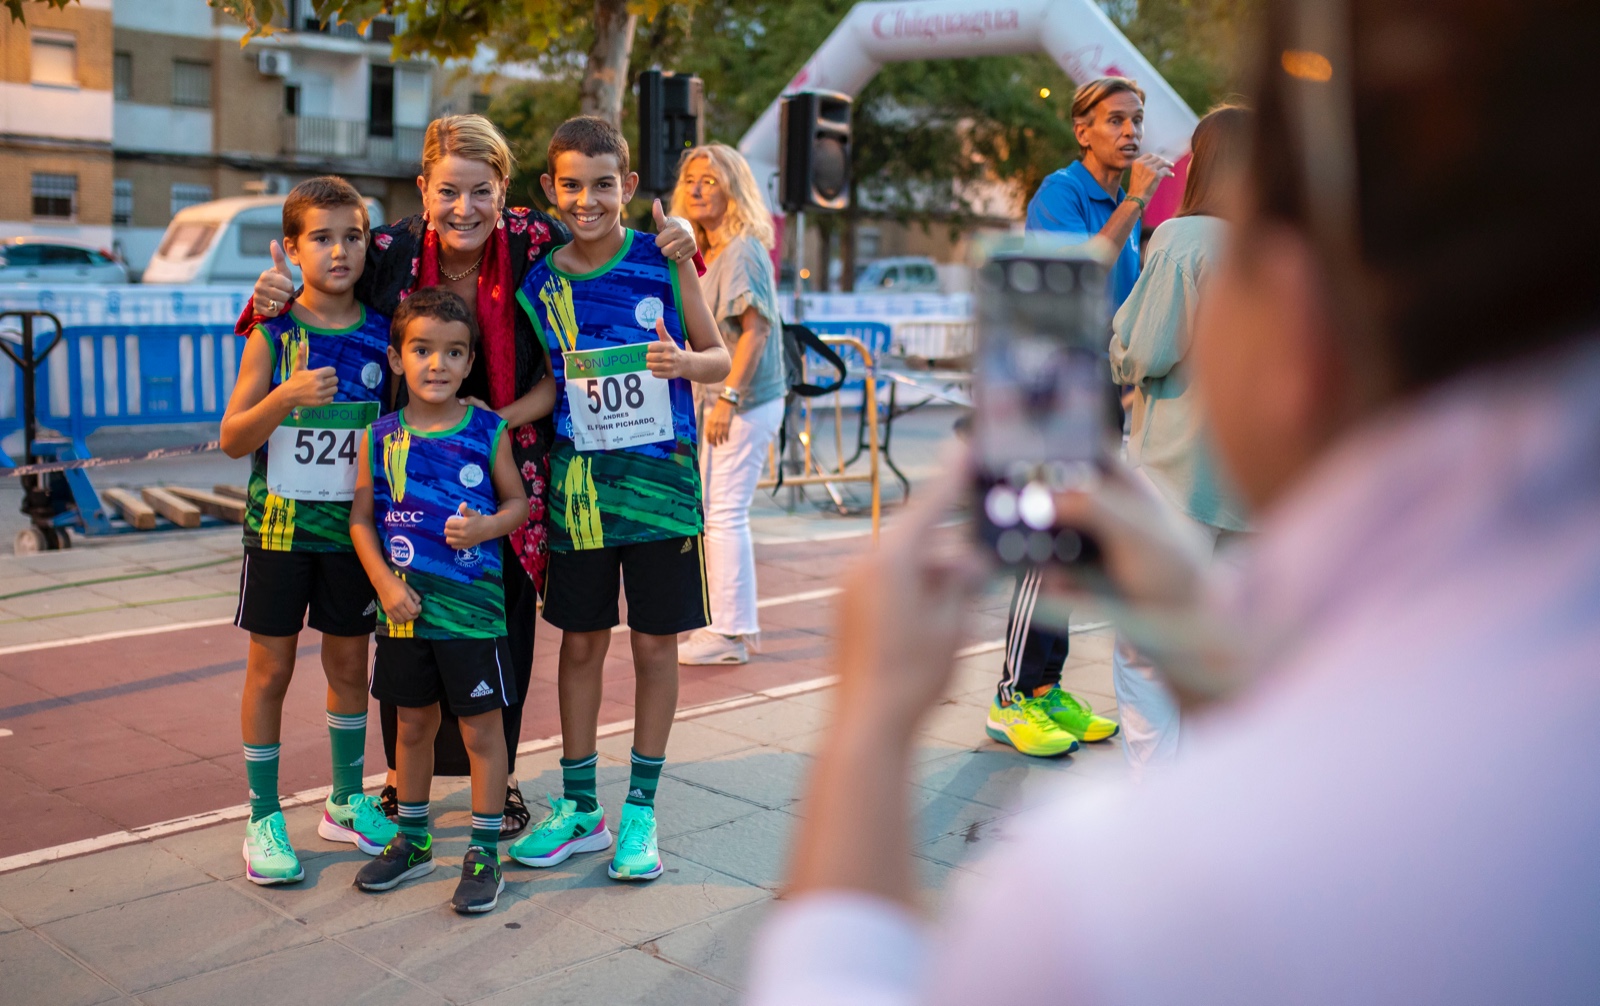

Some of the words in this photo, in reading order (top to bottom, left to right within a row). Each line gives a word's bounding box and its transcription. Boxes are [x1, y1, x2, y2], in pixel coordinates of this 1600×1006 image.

[587, 373, 645, 415] 508
[300, 408, 366, 420] ONUPOLIS
[603, 412, 629, 421] ANDRES
[615, 417, 655, 429] PICHARDO
[294, 429, 357, 465] 524
[384, 510, 424, 523] aecc
[470, 688, 494, 698] adidas
